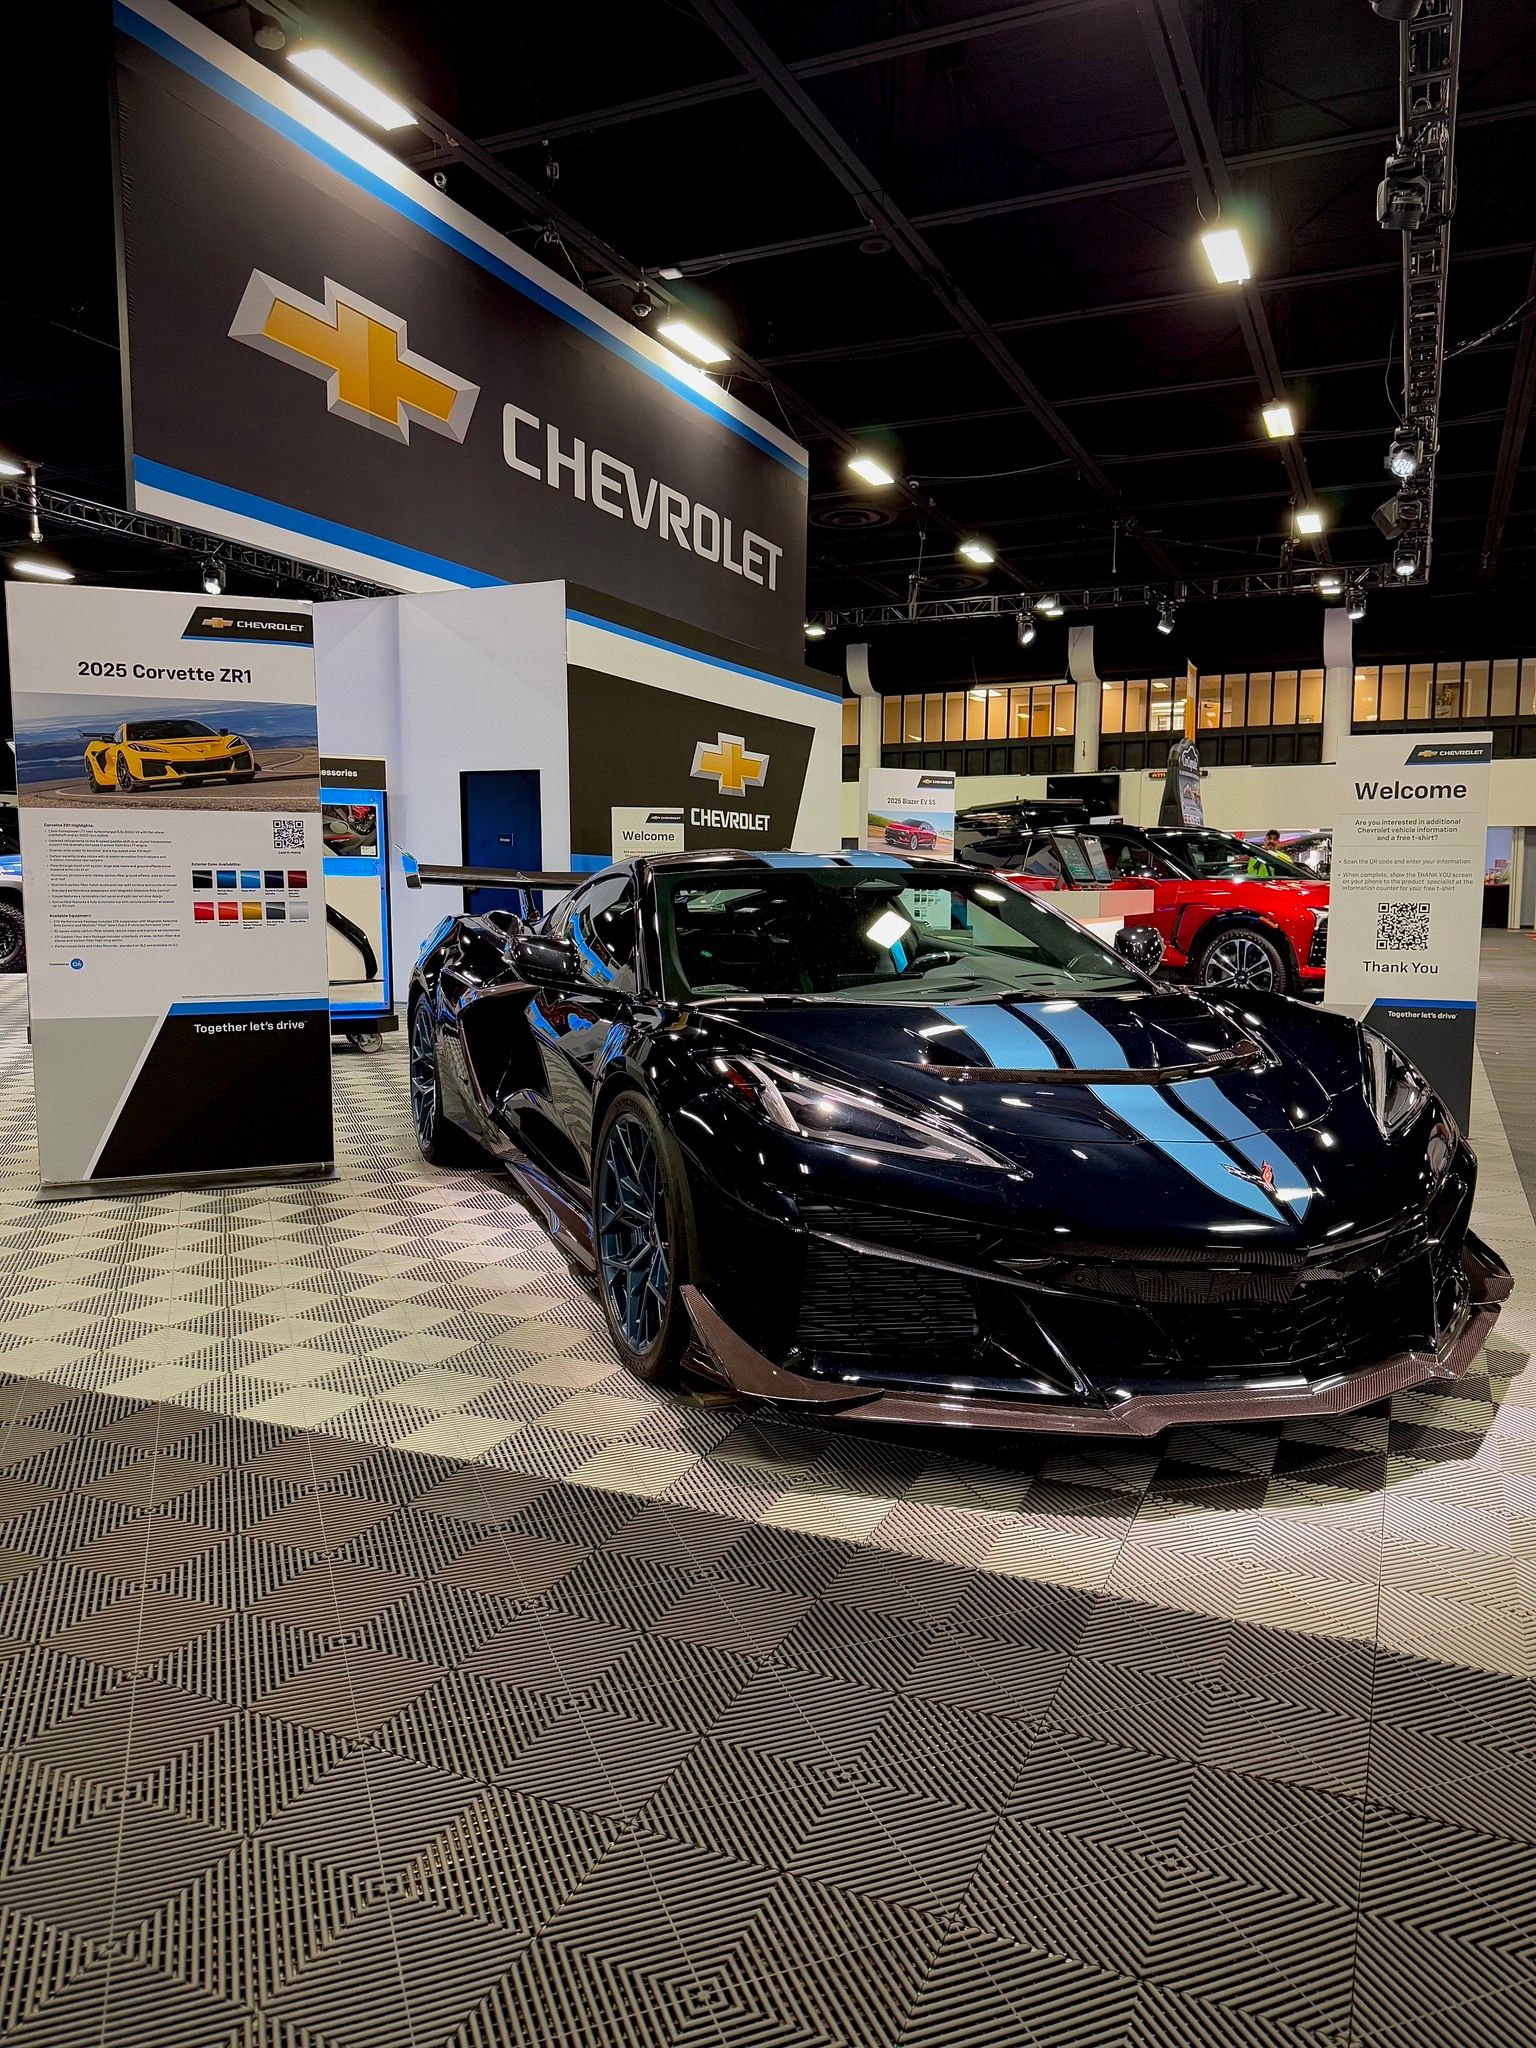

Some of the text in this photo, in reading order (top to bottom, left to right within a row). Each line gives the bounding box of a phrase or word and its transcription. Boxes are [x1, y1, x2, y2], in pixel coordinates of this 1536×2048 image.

[502, 402, 784, 592] CHEVROLET
[236, 620, 305, 632] CHEVROLET
[78, 661, 252, 683] 2025 Corvette ZR1
[1354, 780, 1467, 800] Welcome
[690, 807, 771, 832] CHEVROLET
[622, 830, 675, 841] Welcome
[1362, 960, 1438, 974] Thank You
[1388, 1010, 1420, 1019] Together
[194, 1022, 248, 1034] Together
[250, 1021, 274, 1031] let's
